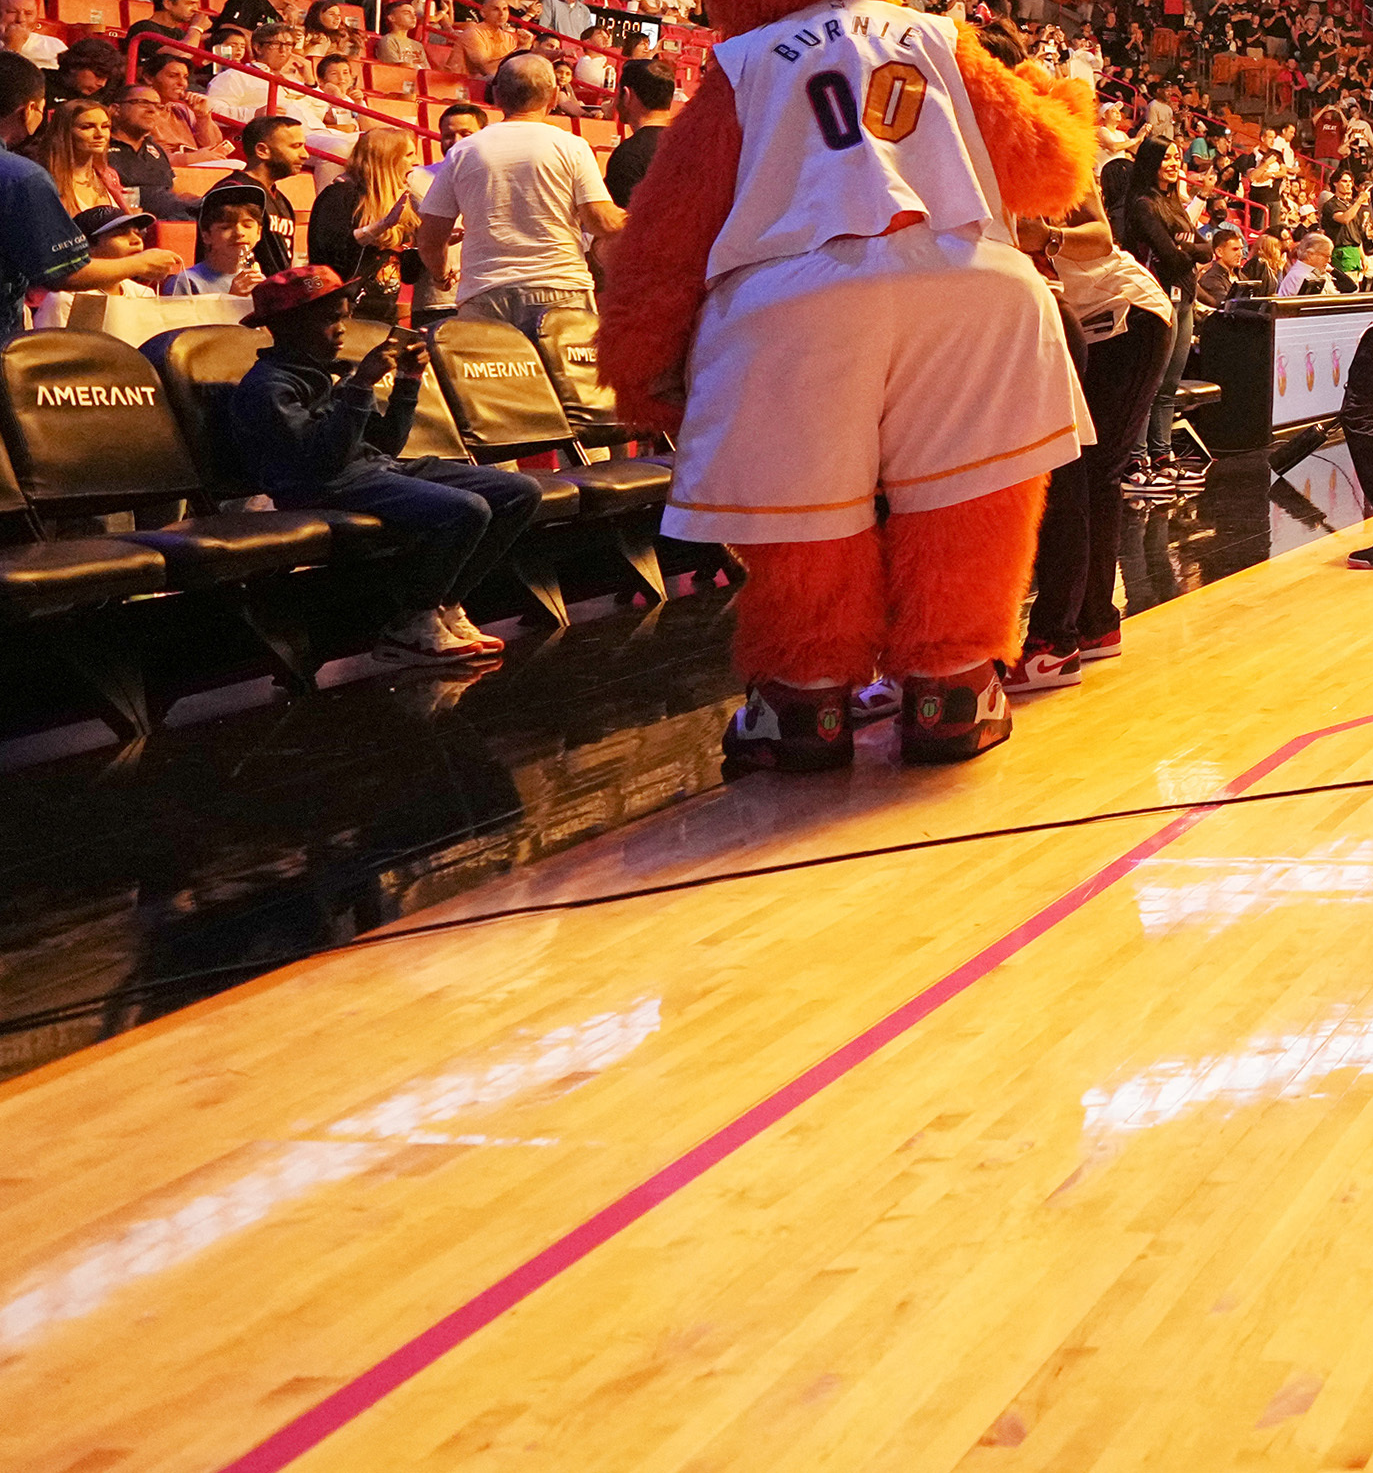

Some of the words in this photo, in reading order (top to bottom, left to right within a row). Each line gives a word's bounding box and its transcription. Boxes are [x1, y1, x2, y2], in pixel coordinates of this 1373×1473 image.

[773, 16, 922, 64] BURNIE
[806, 60, 928, 151] 00
[51, 237, 75, 253] GREY
[463, 360, 537, 379] AMERANT
[37, 385, 156, 406] AMERANT
